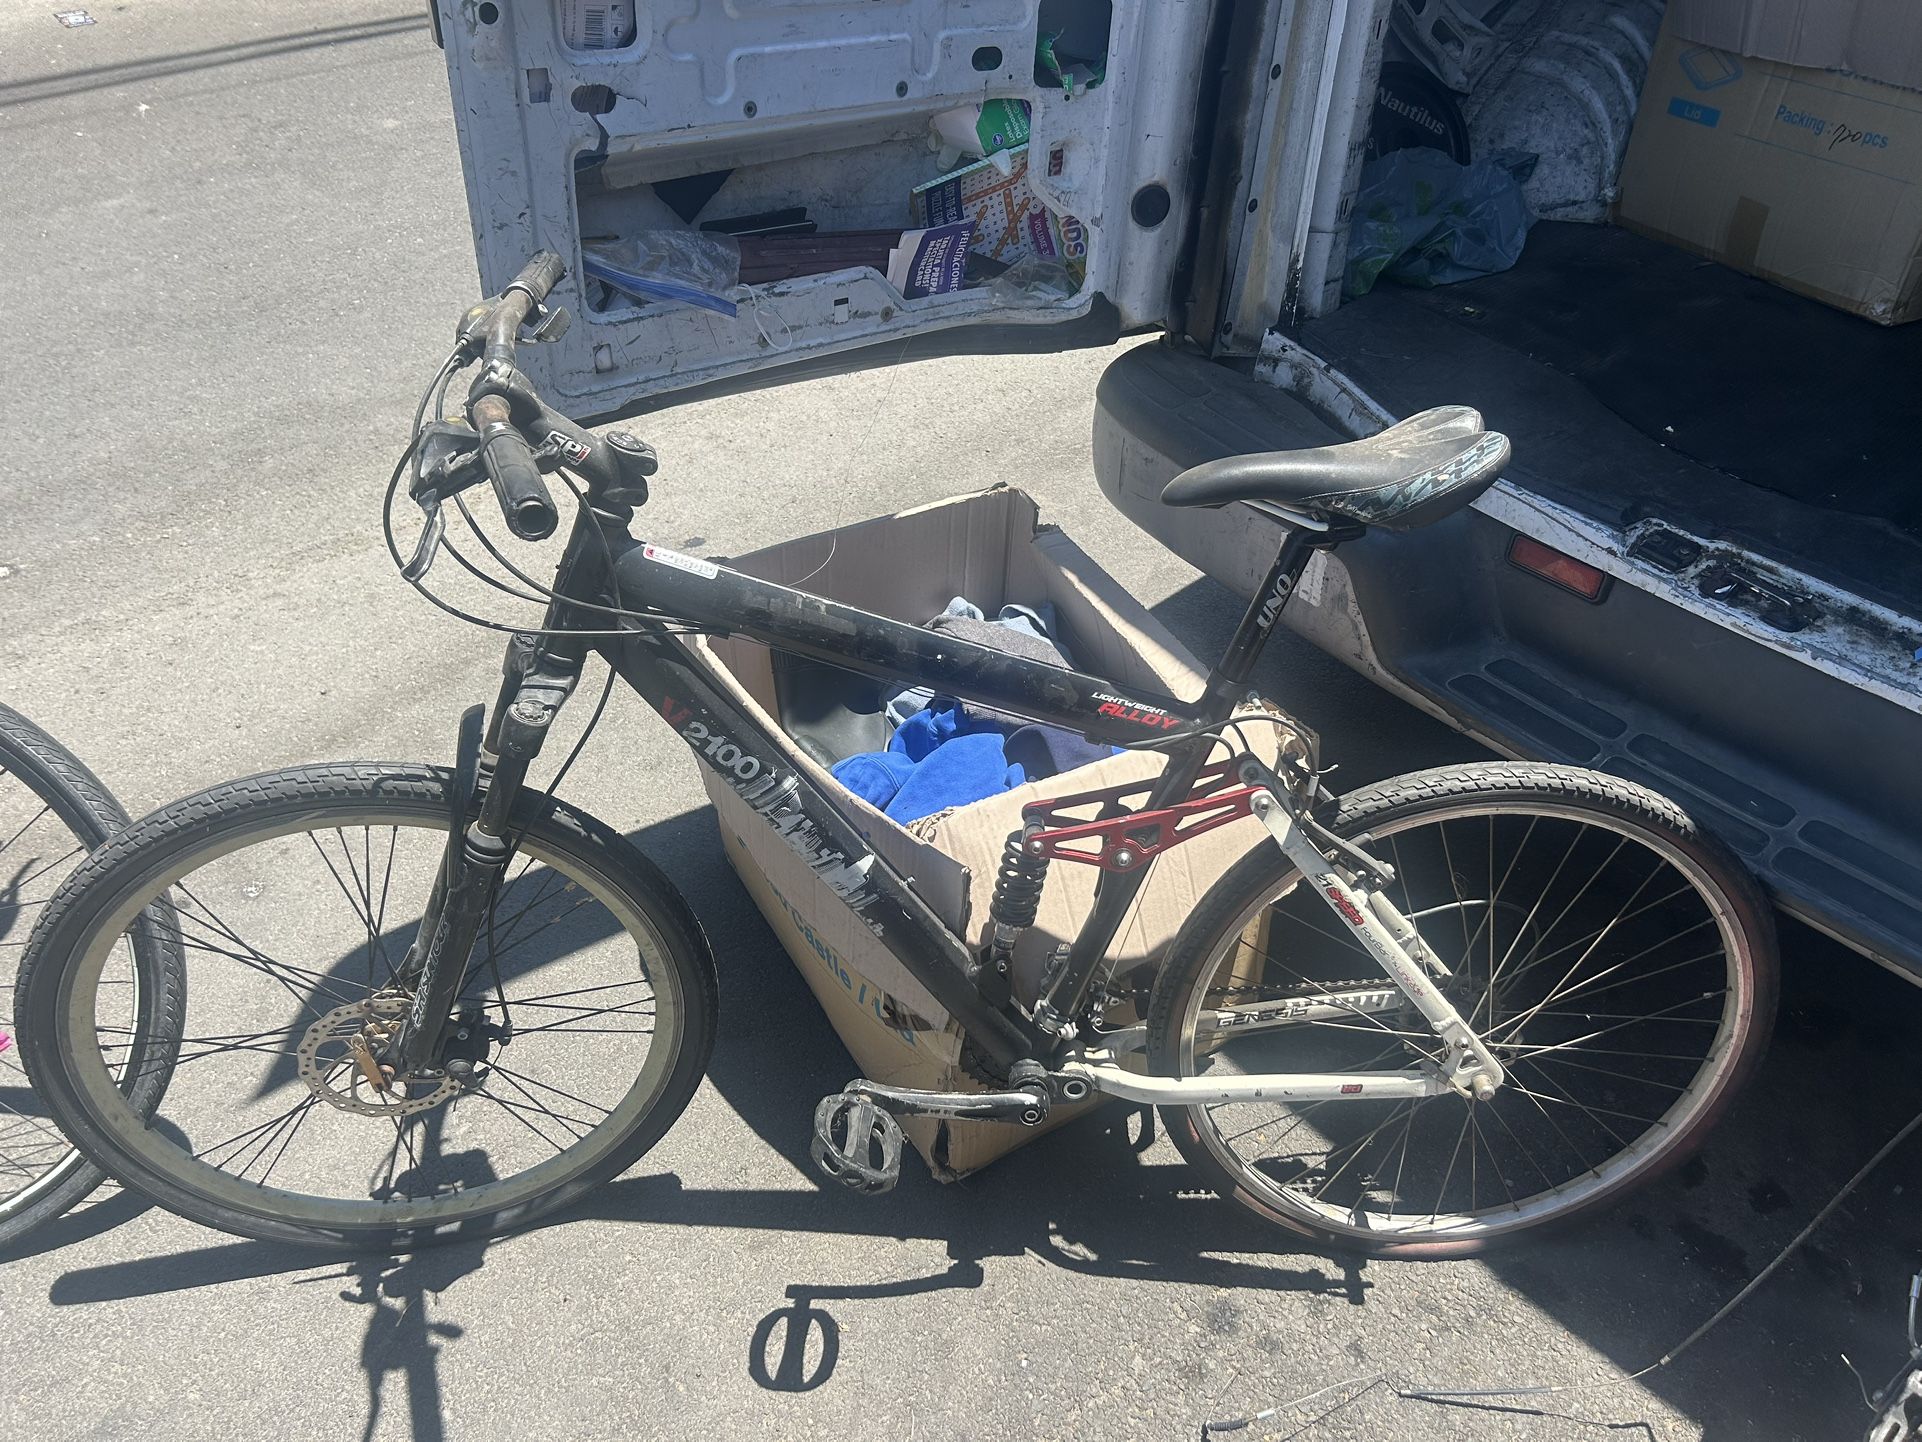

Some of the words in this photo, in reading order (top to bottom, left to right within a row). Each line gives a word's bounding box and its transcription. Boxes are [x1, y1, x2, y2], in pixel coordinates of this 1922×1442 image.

[1376, 86, 1445, 135] Nautilus
[1004, 122, 1016, 142] Latex
[1860, 131, 1889, 149] pcs
[1256, 573, 1292, 628] UNO
[1091, 692, 1168, 716] LIGHTWEIGHT
[1098, 702, 1180, 730] ALLOY
[1326, 887, 1364, 926] SPEED
[1216, 1006, 1309, 1029] GENESIS
